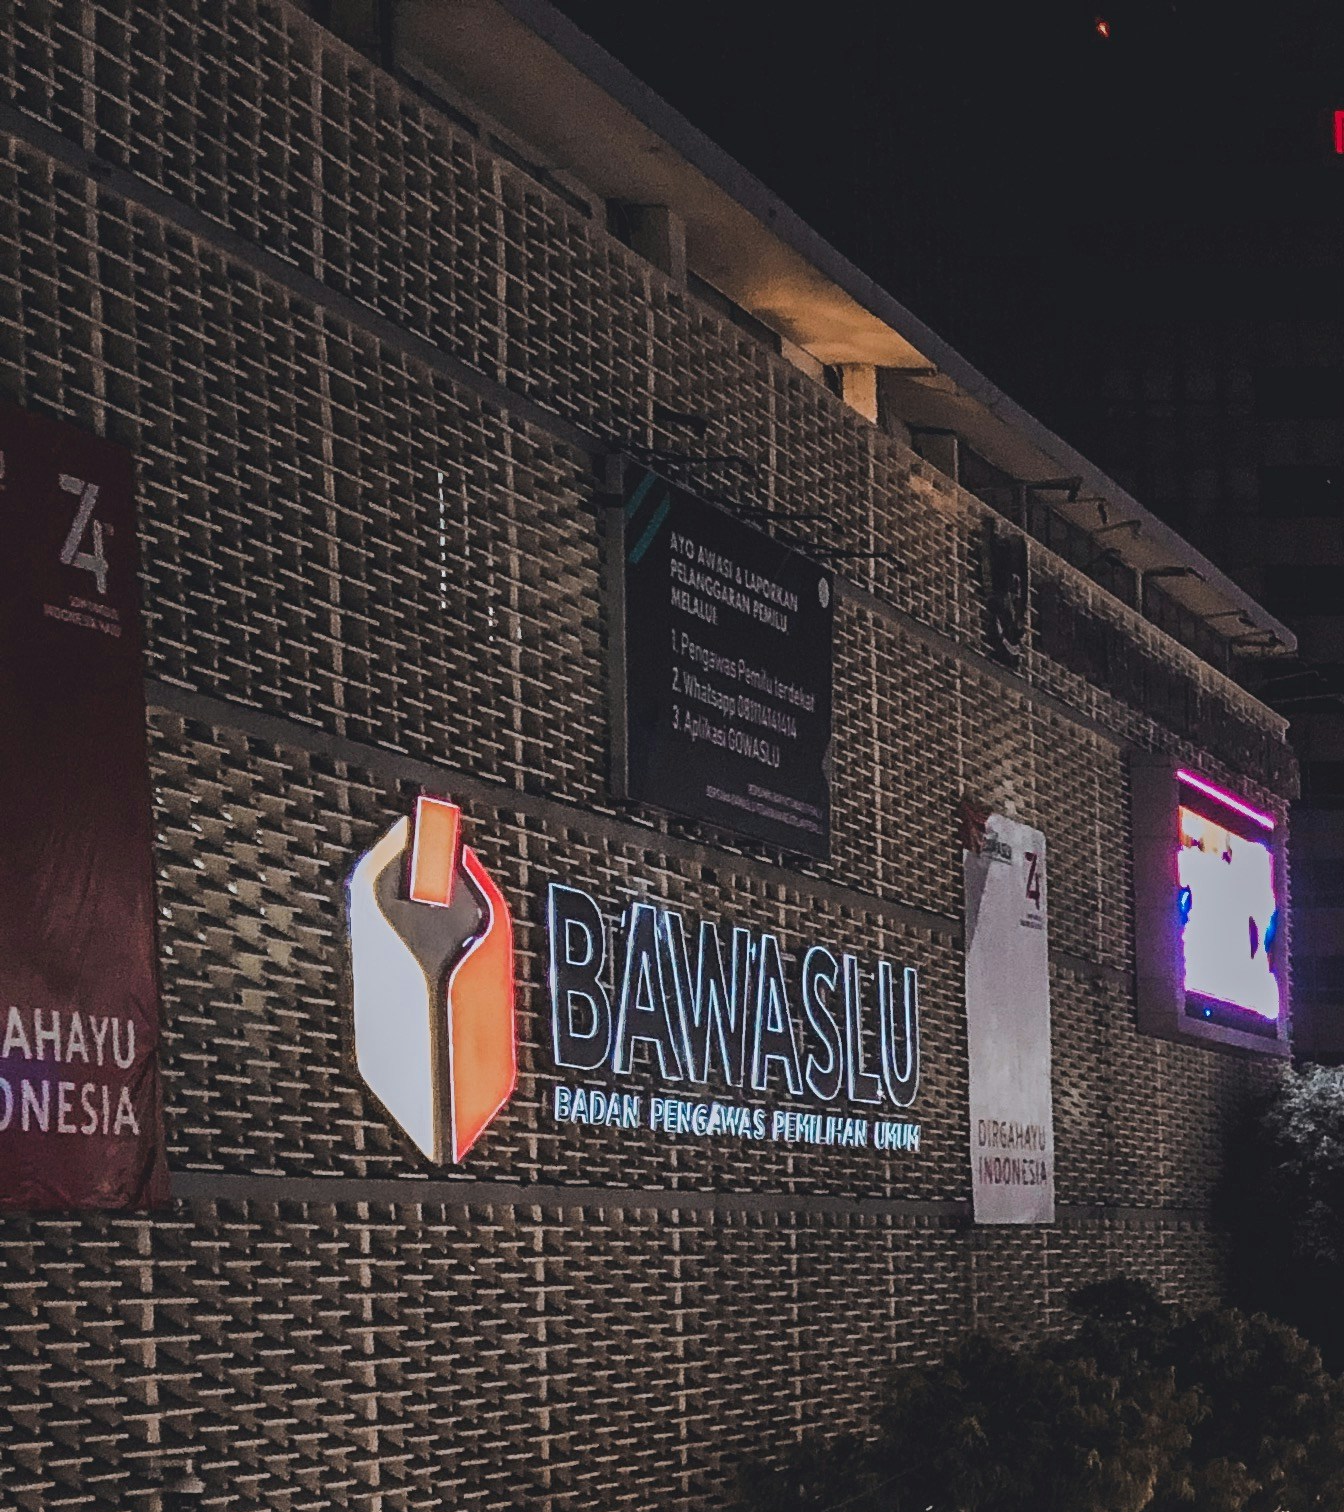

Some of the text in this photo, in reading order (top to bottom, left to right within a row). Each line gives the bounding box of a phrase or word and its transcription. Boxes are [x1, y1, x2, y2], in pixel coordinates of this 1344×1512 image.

[670, 531, 695, 559] AYO
[698, 546, 733, 579] AWASI
[744, 569, 798, 612] LAPORKAN
[670, 558, 750, 614] PELANGGARAN
[681, 632, 736, 679] Pengawas
[738, 658, 772, 694] Pemilu
[684, 710, 727, 747] Aplikasi
[728, 727, 780, 768] GOWASLU
[548, 882, 921, 1107] BAWASLU
[555, 1086, 921, 1152] BADAN PENGAWAS PEMILIHAN UMUM
[978, 1119, 1046, 1151] DIRGAHAYU
[978, 1156, 1047, 1186] INDONESIA
